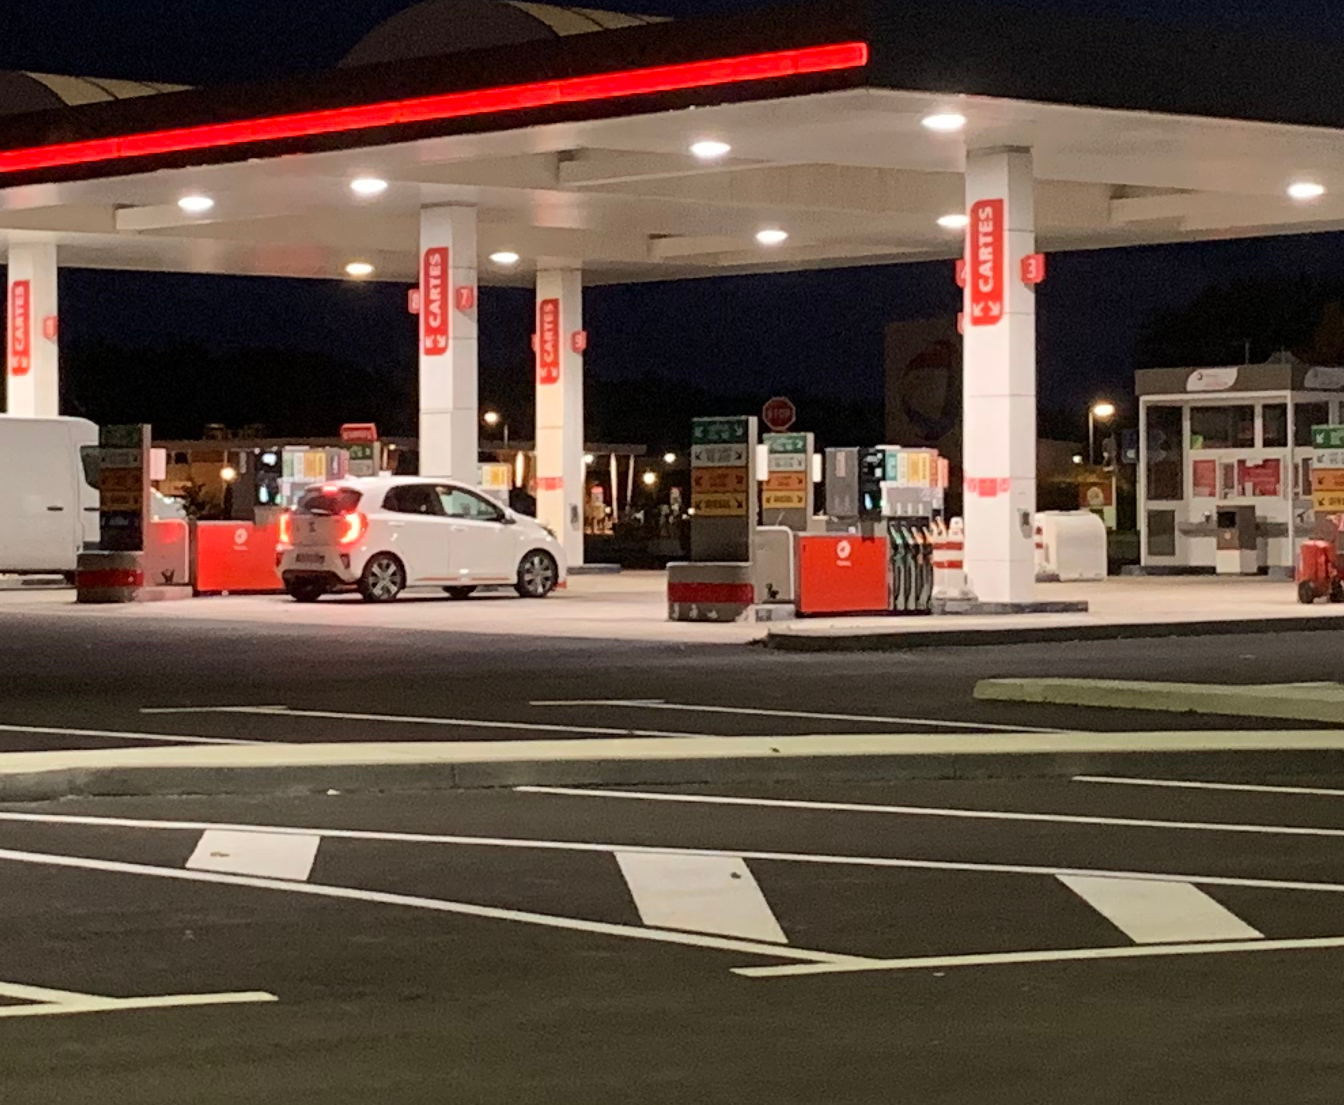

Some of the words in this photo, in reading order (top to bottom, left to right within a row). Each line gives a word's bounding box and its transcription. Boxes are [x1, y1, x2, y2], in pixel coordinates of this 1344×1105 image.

[978, 206, 994, 293] CARTES
[1026, 258, 1037, 279] 3
[14, 285, 25, 352] CARTES
[428, 253, 441, 328] CARTES
[543, 301, 554, 363] CARTES
